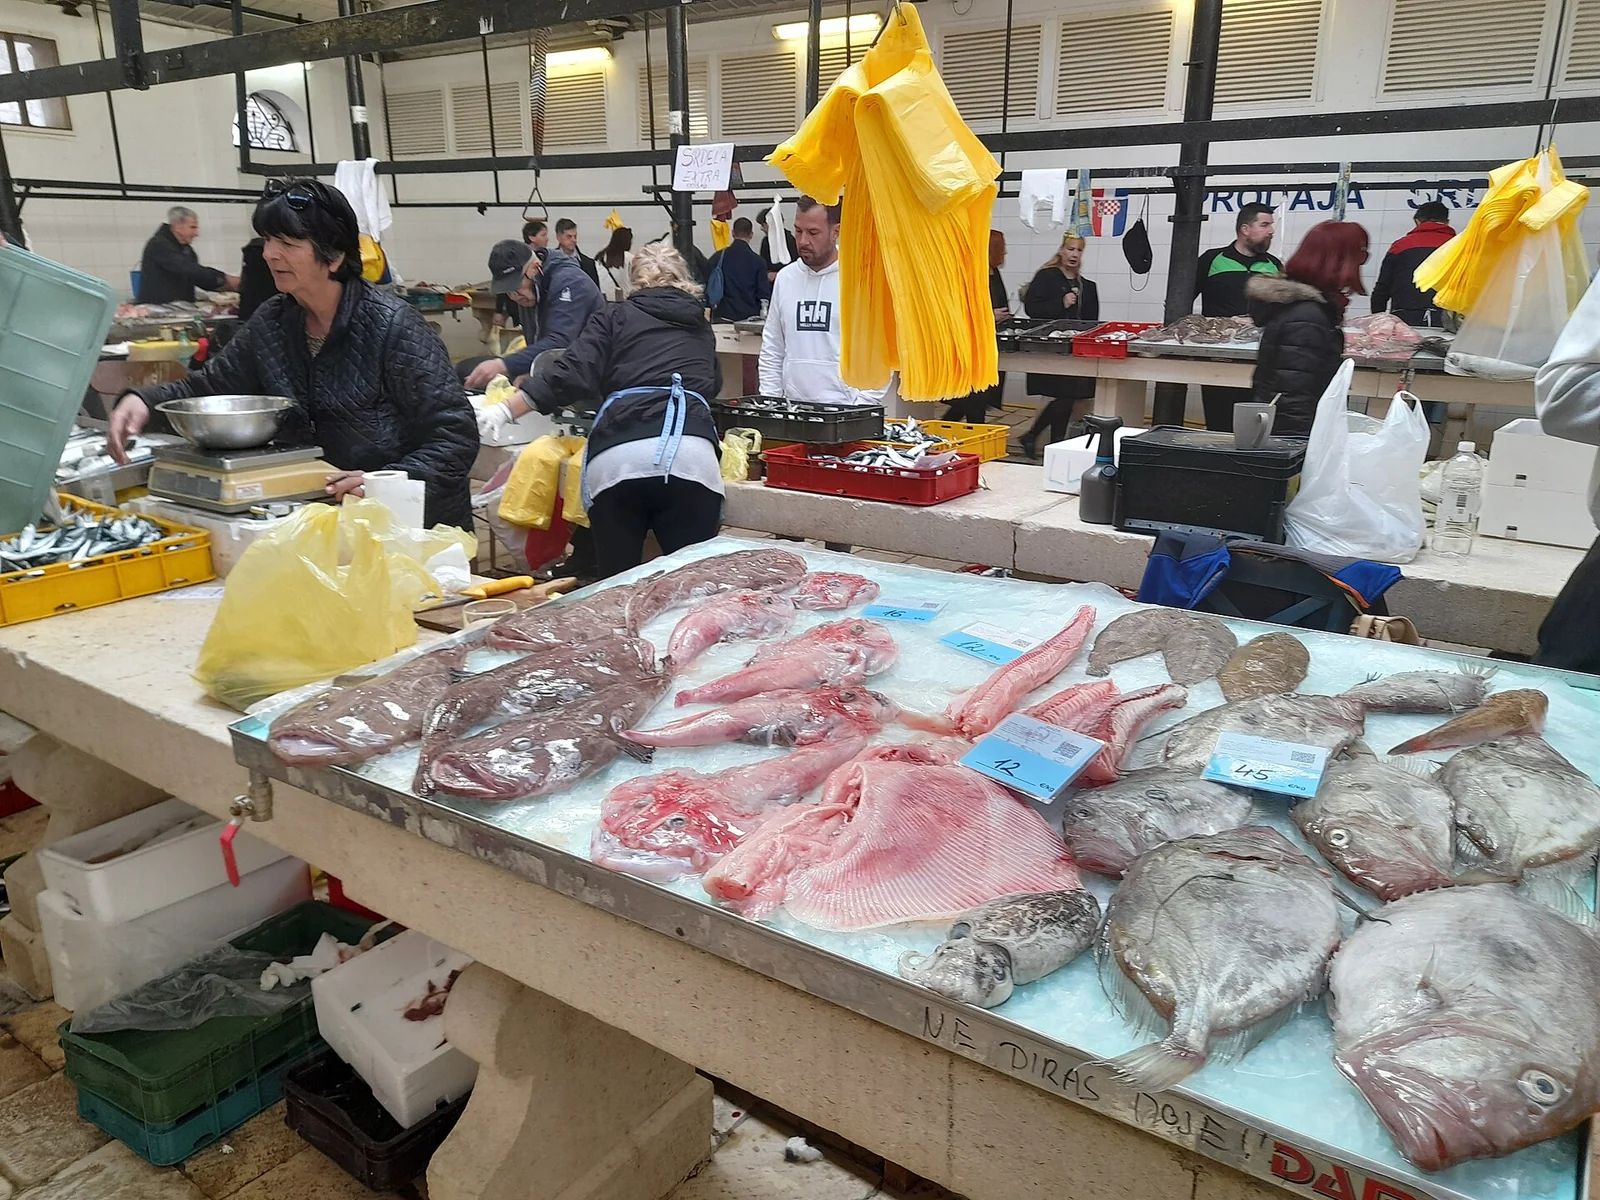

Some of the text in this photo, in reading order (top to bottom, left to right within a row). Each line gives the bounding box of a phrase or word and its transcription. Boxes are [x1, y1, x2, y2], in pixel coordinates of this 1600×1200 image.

[682, 169, 720, 184] EXTRA
[1202, 182, 1365, 213] RODAJA
[883, 609, 907, 618] 16
[994, 759, 1021, 777] 12
[1234, 764, 1274, 781] 45
[922, 1006, 976, 1050] NE
